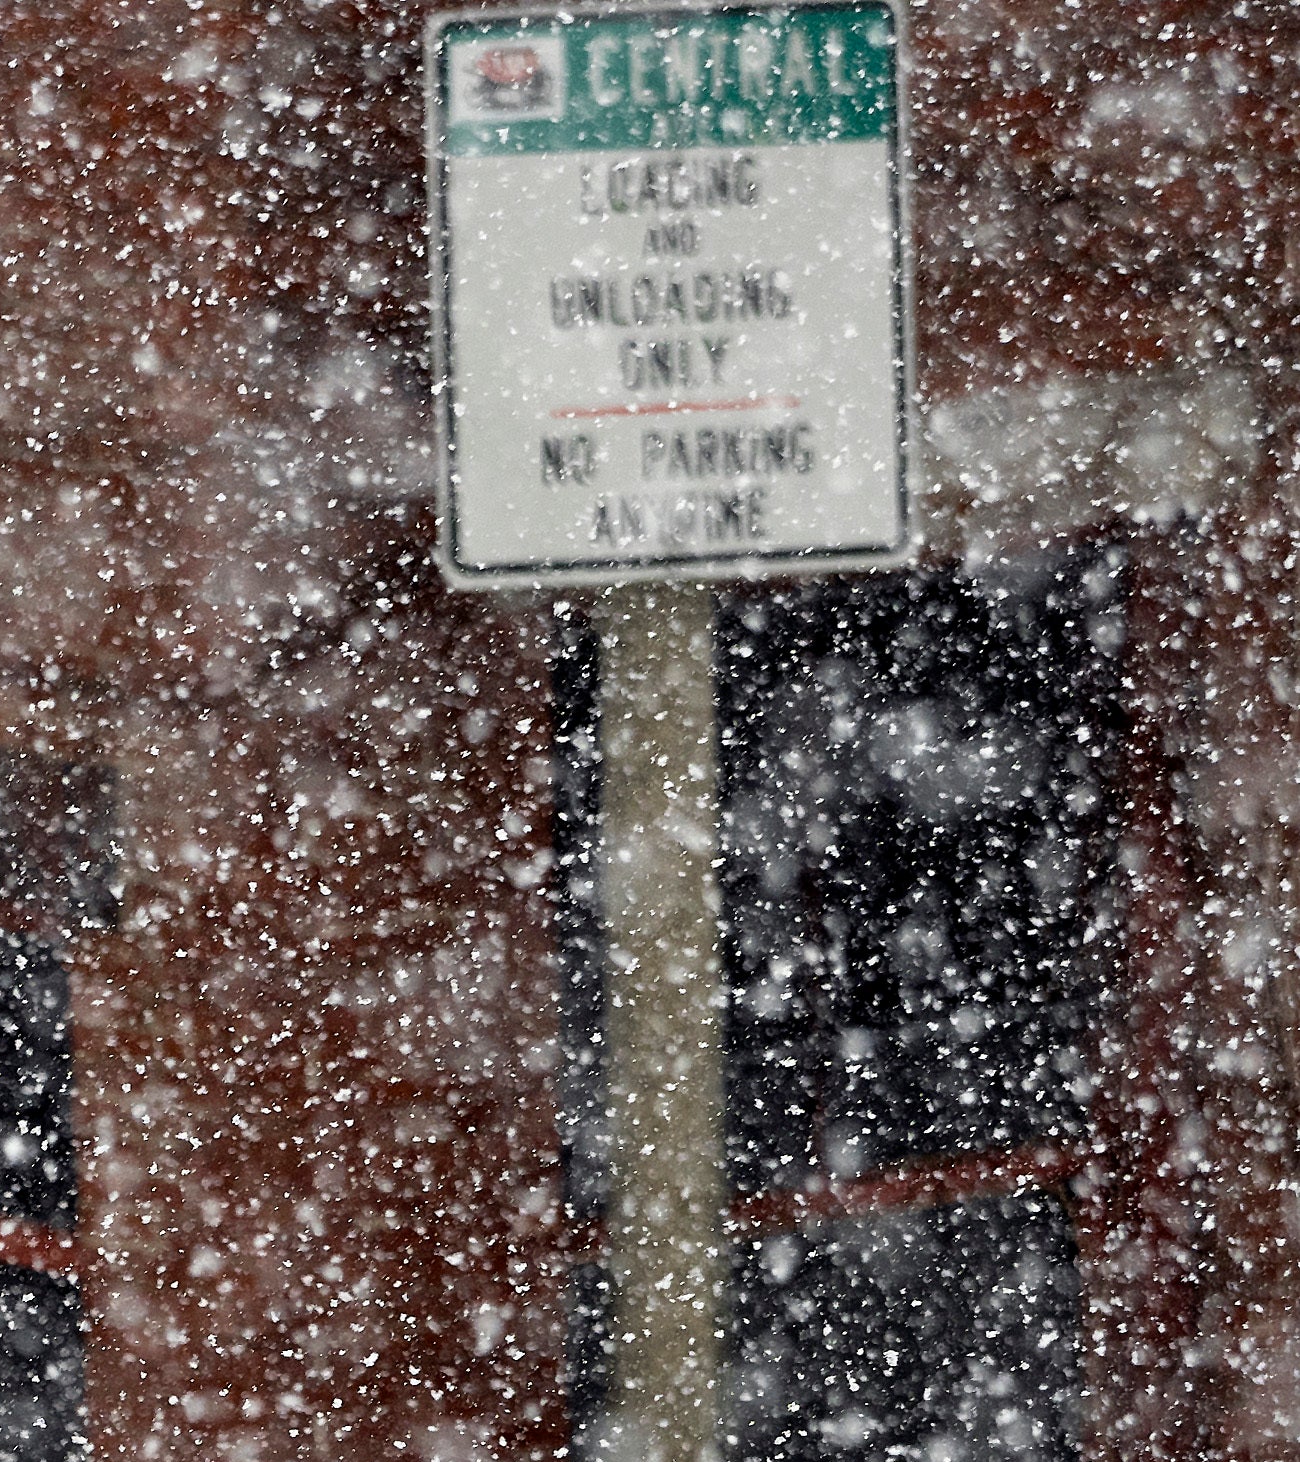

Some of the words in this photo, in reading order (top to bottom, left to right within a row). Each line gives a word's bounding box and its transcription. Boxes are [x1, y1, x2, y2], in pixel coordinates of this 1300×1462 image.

[586, 29, 856, 105] CENTRAL
[540, 433, 596, 487] NO
[640, 420, 814, 481] PARKING
[594, 489, 767, 548] ANIME
